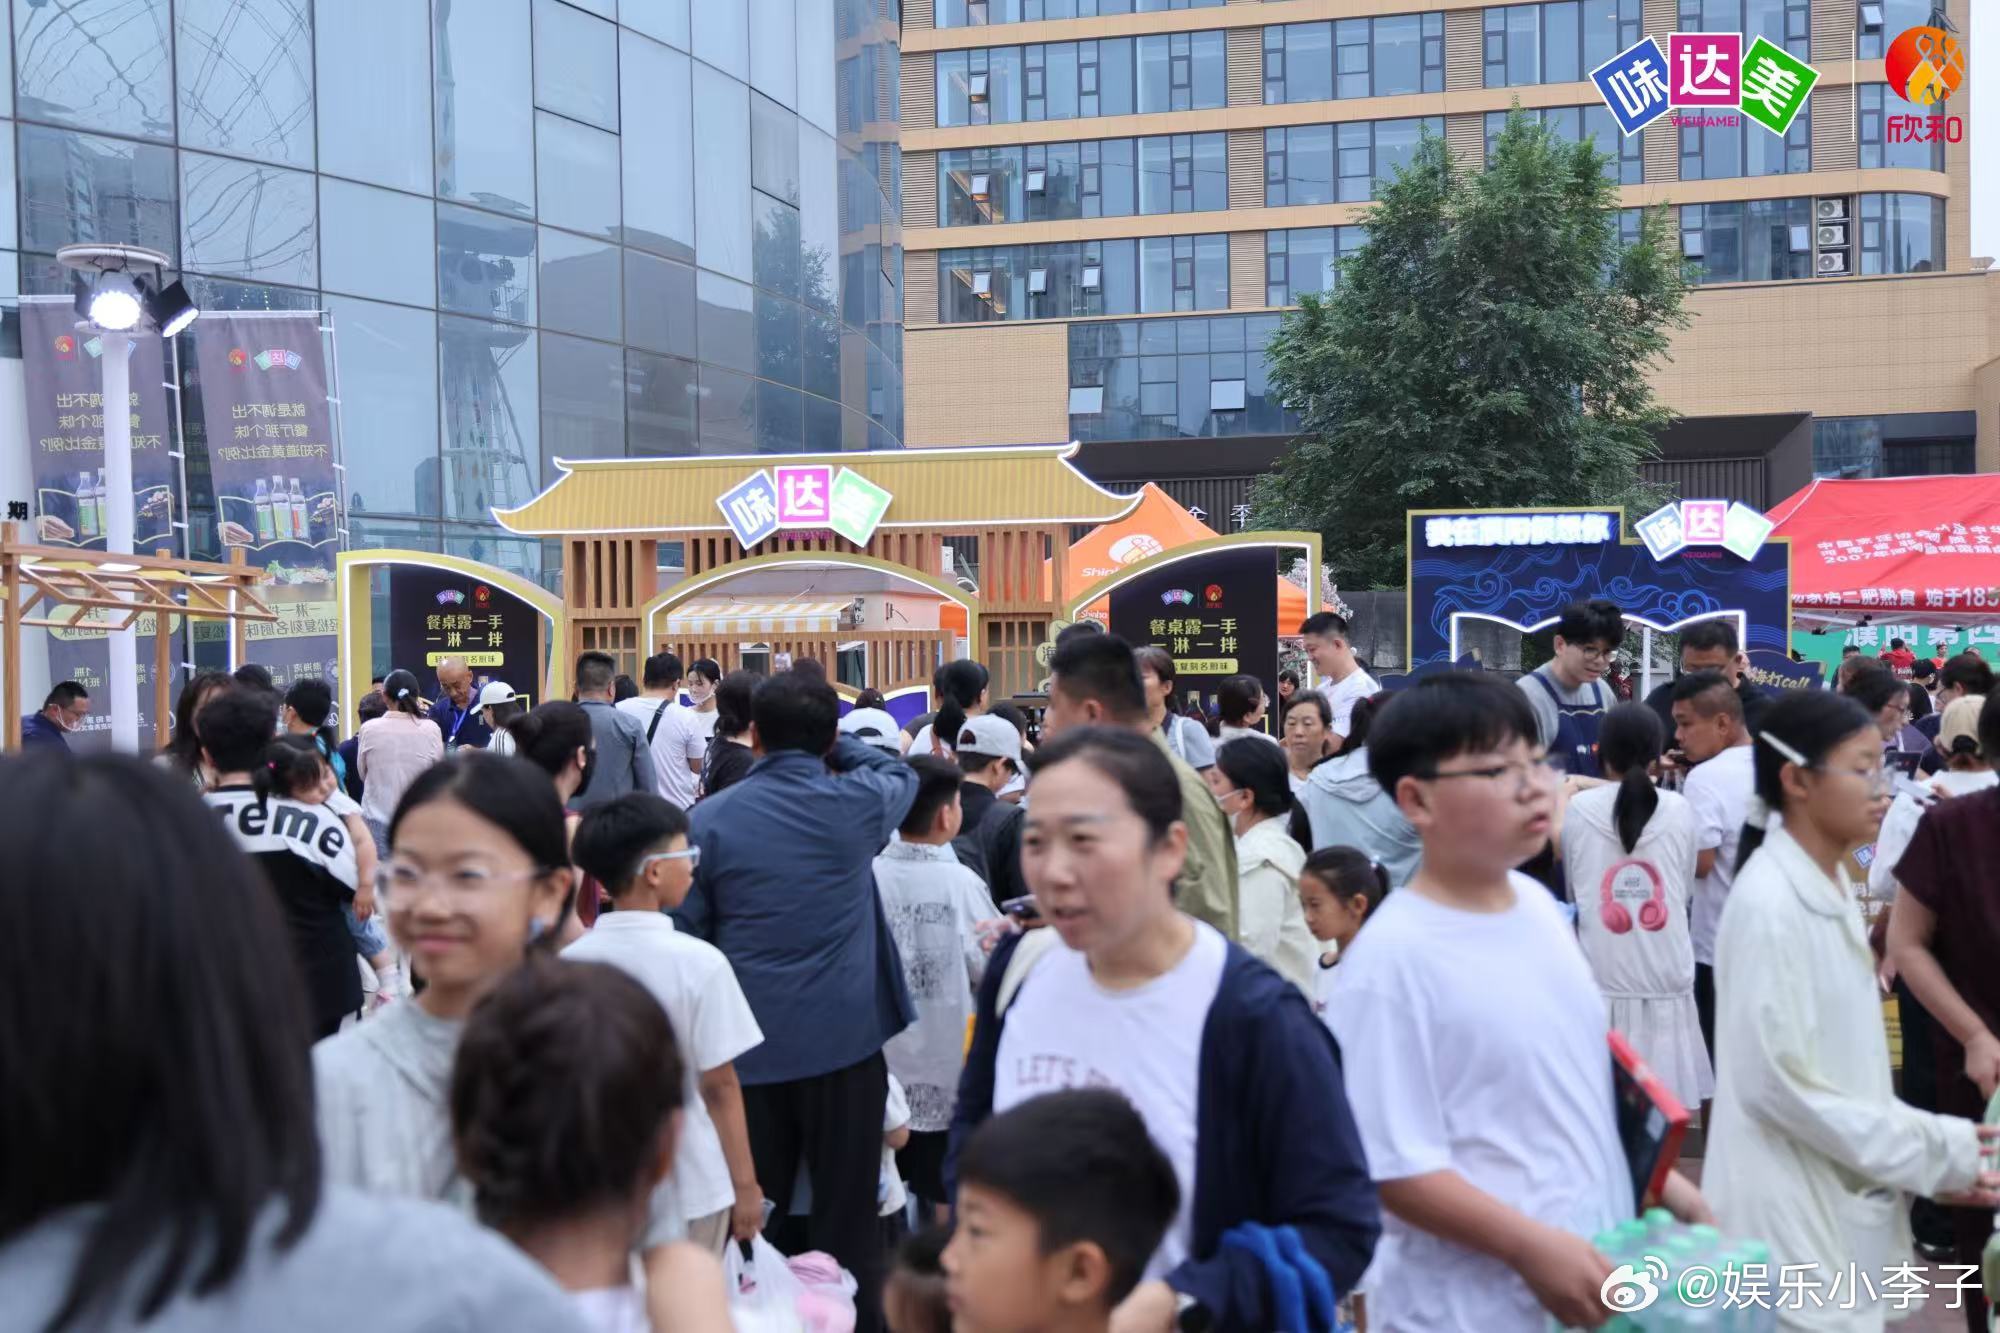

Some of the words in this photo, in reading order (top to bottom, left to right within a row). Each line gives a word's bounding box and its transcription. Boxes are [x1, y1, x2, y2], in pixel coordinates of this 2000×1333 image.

[426, 614, 504, 630] 餐桌露一手
[1149, 618, 1238, 635] 餐桌露一手
[426, 631, 504, 647] 一淋一拌
[1149, 637, 1238, 654] 一淋一拌
